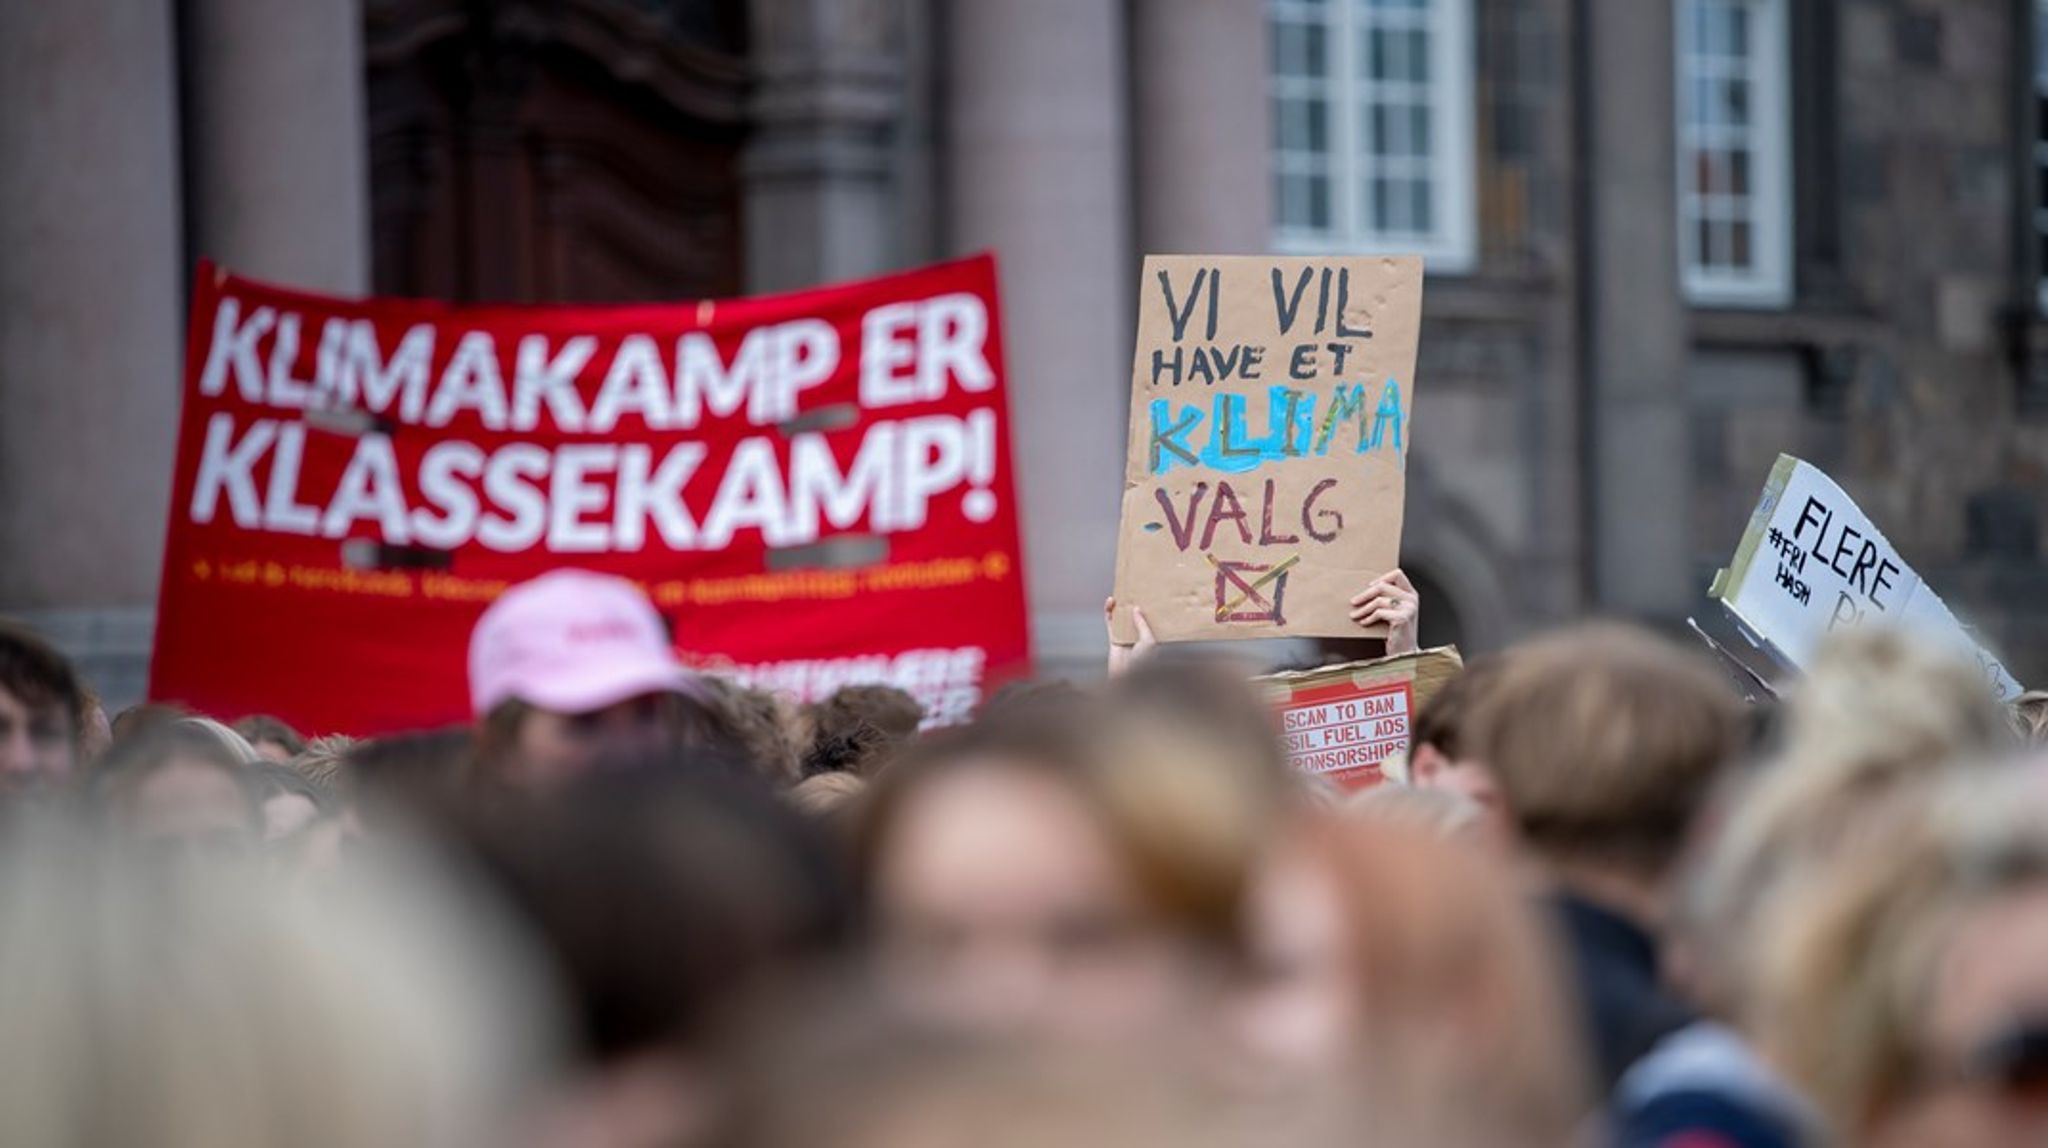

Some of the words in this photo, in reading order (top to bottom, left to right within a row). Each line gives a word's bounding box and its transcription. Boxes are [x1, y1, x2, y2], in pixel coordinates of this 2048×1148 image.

[1158, 268, 1220, 342] VI
[1272, 266, 1373, 338] VIL
[199, 297, 841, 434] KLIMAKAMP
[858, 292, 996, 409] ER
[1152, 345, 1265, 386] HAVE
[1289, 343, 1352, 379] ET
[1148, 379, 1405, 474] KLIMA
[190, 406, 997, 553] KLASSEKAMP!
[1769, 527, 1807, 575] #FRI
[1794, 495, 1900, 612] FLERE
[1285, 708, 1327, 729] SCAN
[1336, 704, 1356, 720] TO
[1364, 697, 1395, 716] BAN
[1288, 733, 1316, 751] SIL
[1323, 725, 1366, 745] FUEL
[1375, 718, 1405, 736] ADS
[1291, 741, 1406, 770] PONSORSHIPS
